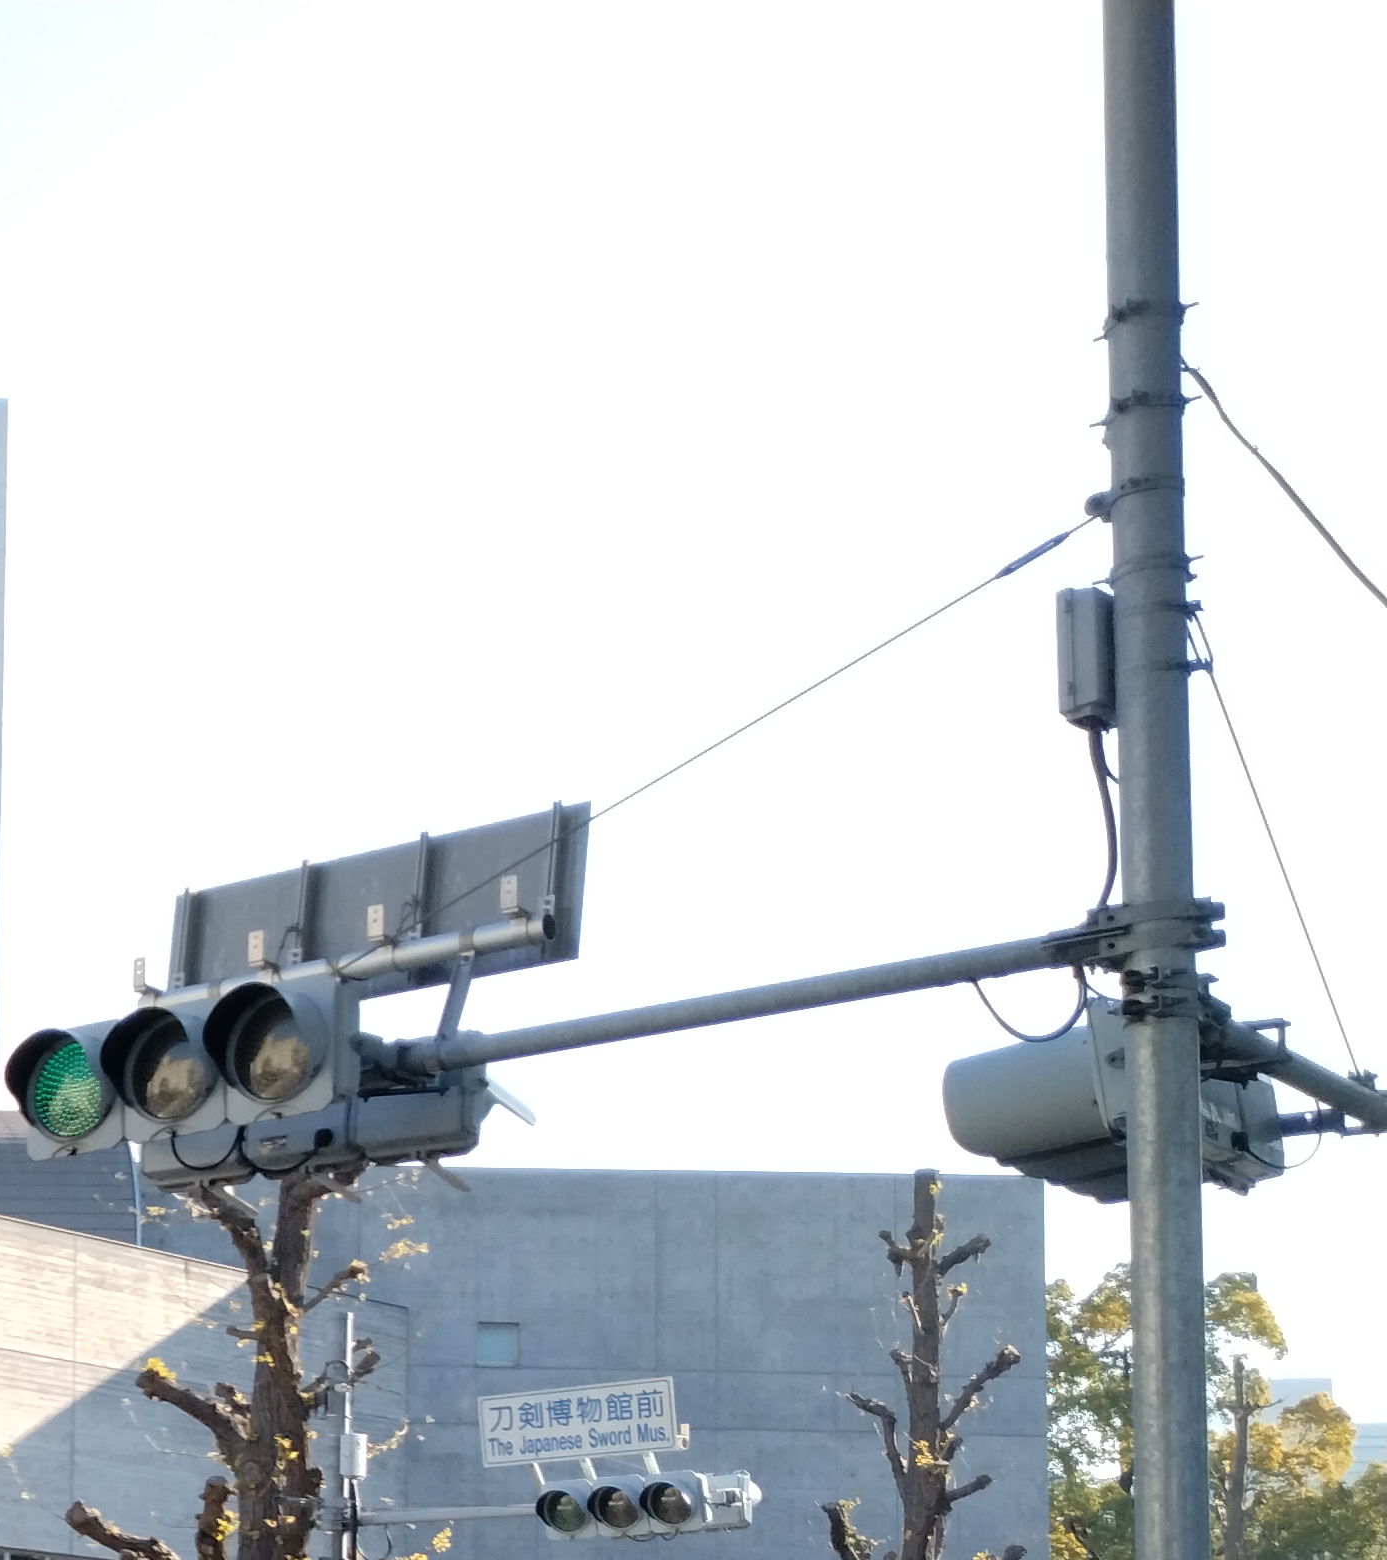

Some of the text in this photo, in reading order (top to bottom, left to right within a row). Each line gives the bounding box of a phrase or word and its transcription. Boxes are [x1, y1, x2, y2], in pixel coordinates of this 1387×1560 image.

[489, 1389, 665, 1433] 刀剣博物館前
[488, 1422, 670, 1457] The Japanese Sword Mus.
